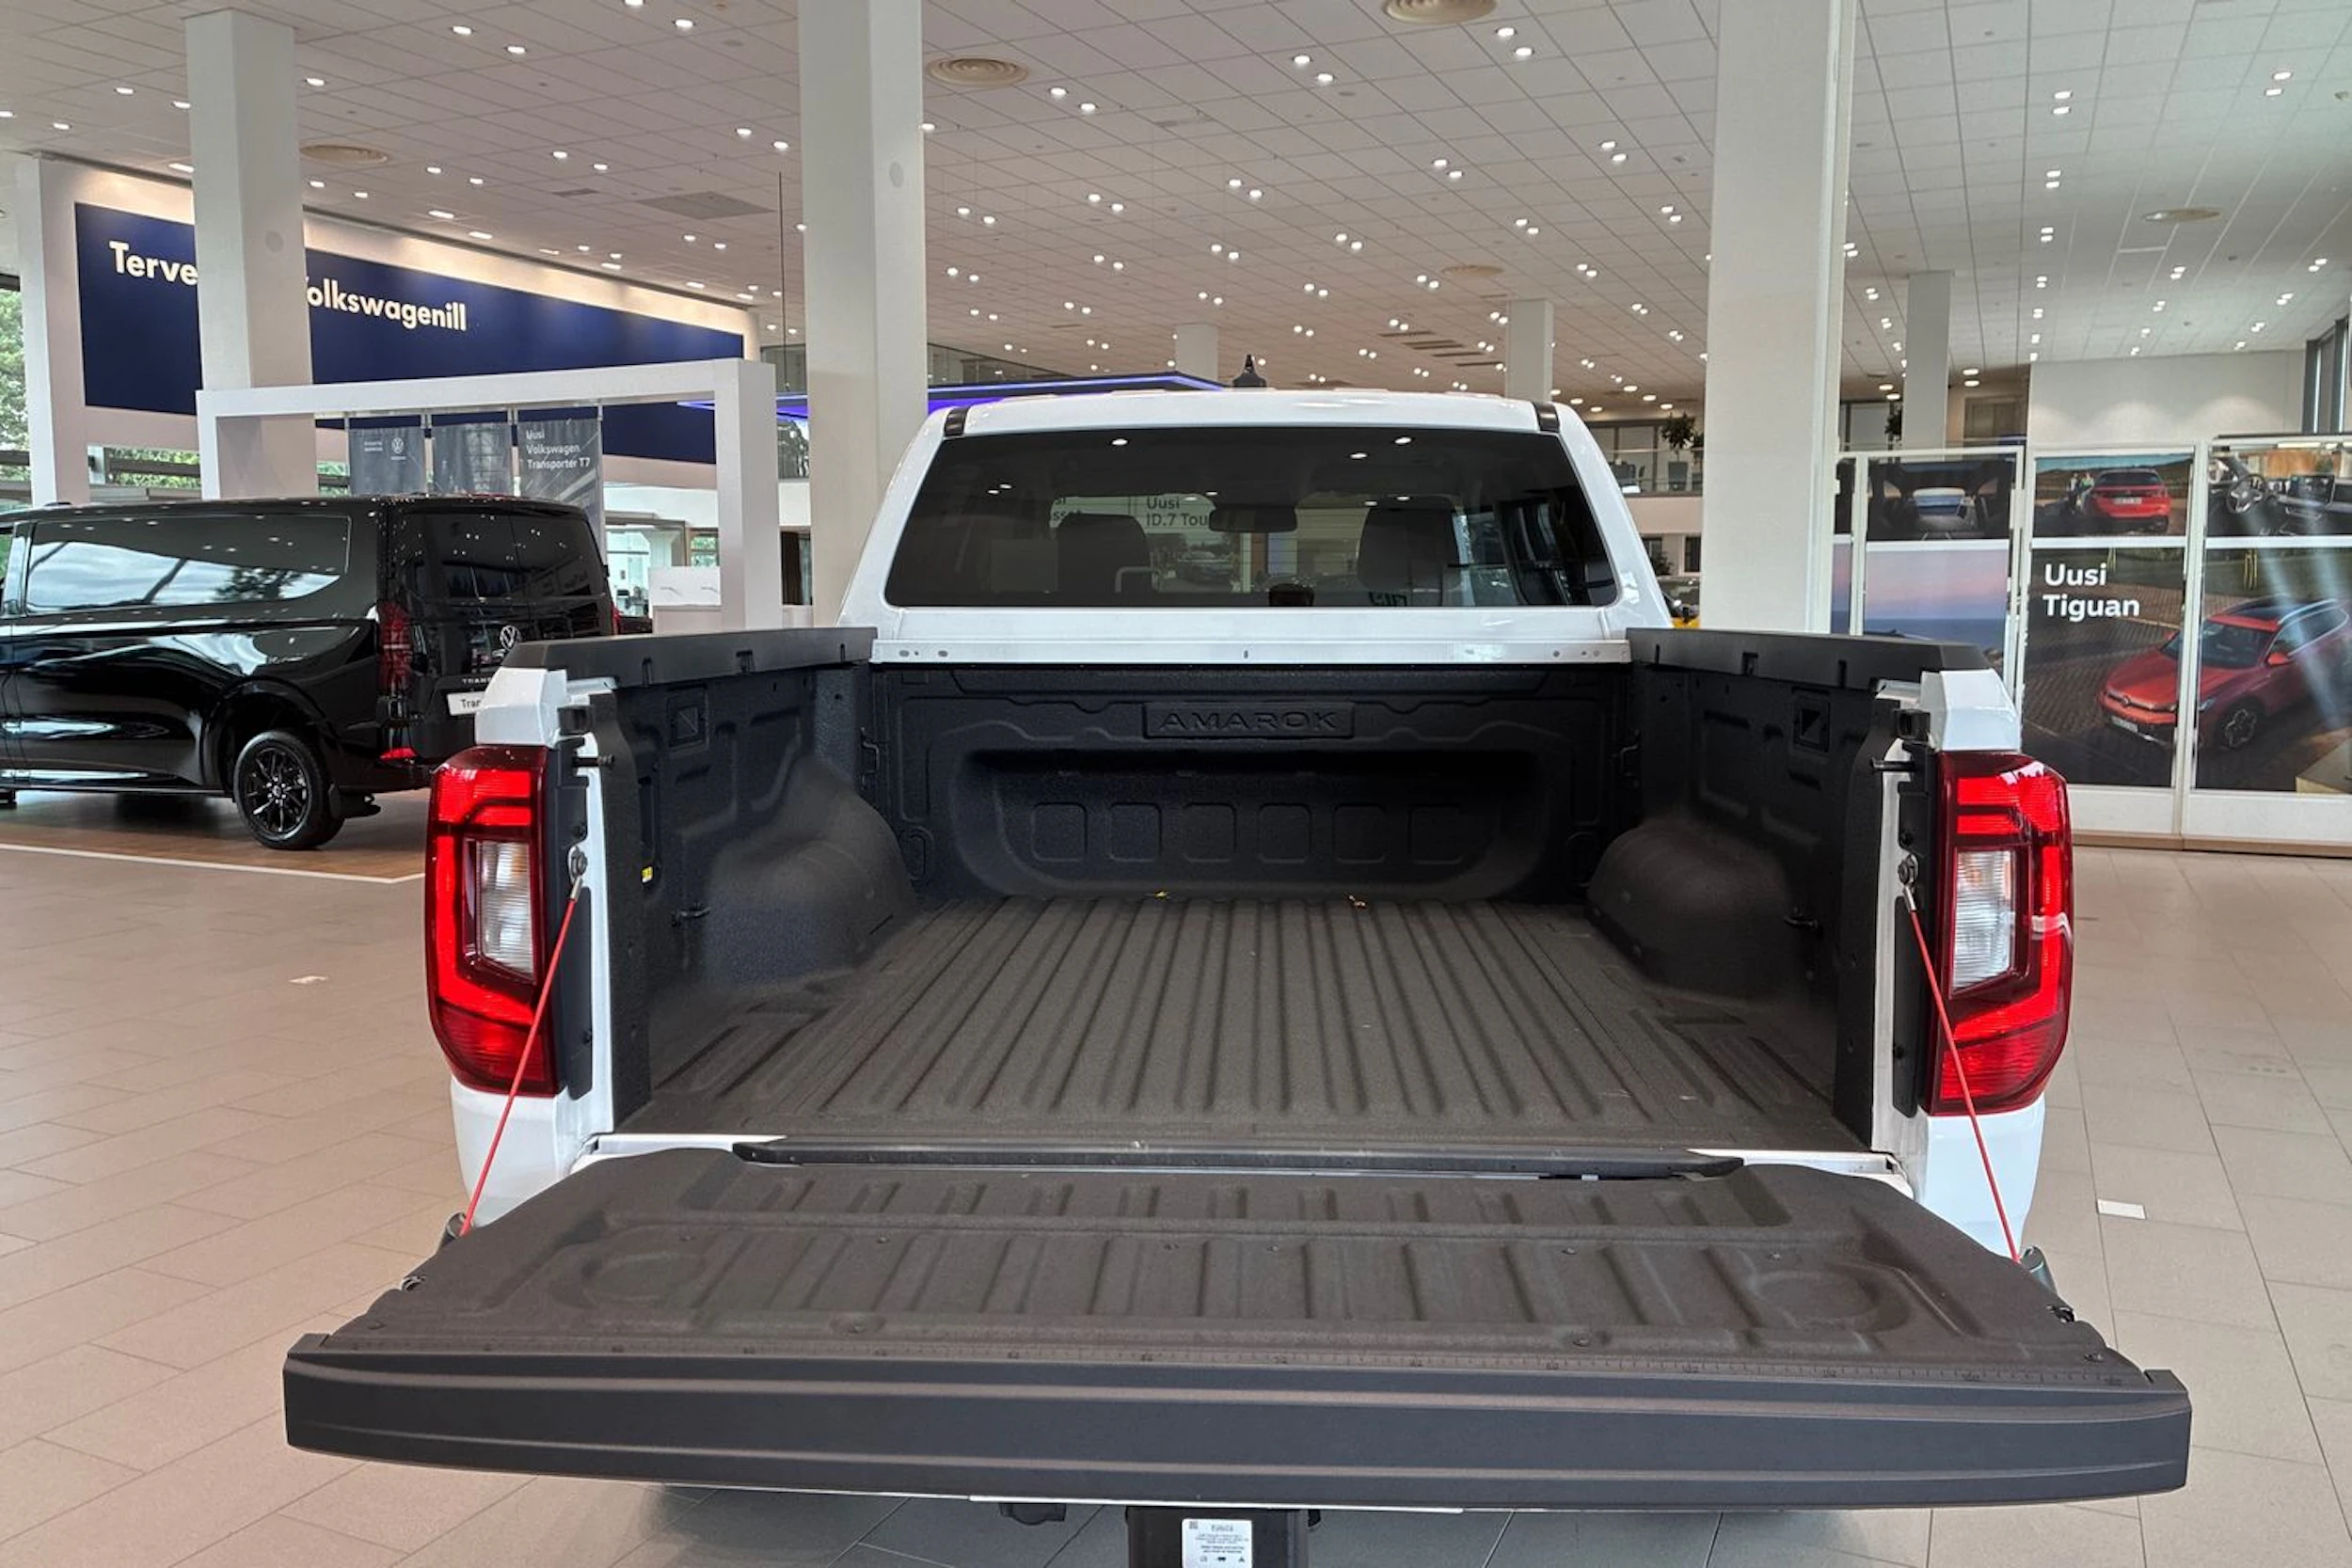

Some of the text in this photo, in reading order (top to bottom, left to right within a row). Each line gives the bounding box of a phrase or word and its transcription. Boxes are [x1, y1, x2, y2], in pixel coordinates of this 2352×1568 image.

[306, 277, 467, 331] olkswagenill
[526, 444, 580, 455] Volkswagen
[527, 457, 591, 470] Transporter T7
[1146, 497, 1180, 510] Uusi
[1146, 514, 1176, 527] ID.7
[2044, 562, 2107, 586] Uusi
[2042, 594, 2140, 623] Tiguan
[1159, 711, 1337, 731] AMAROK
